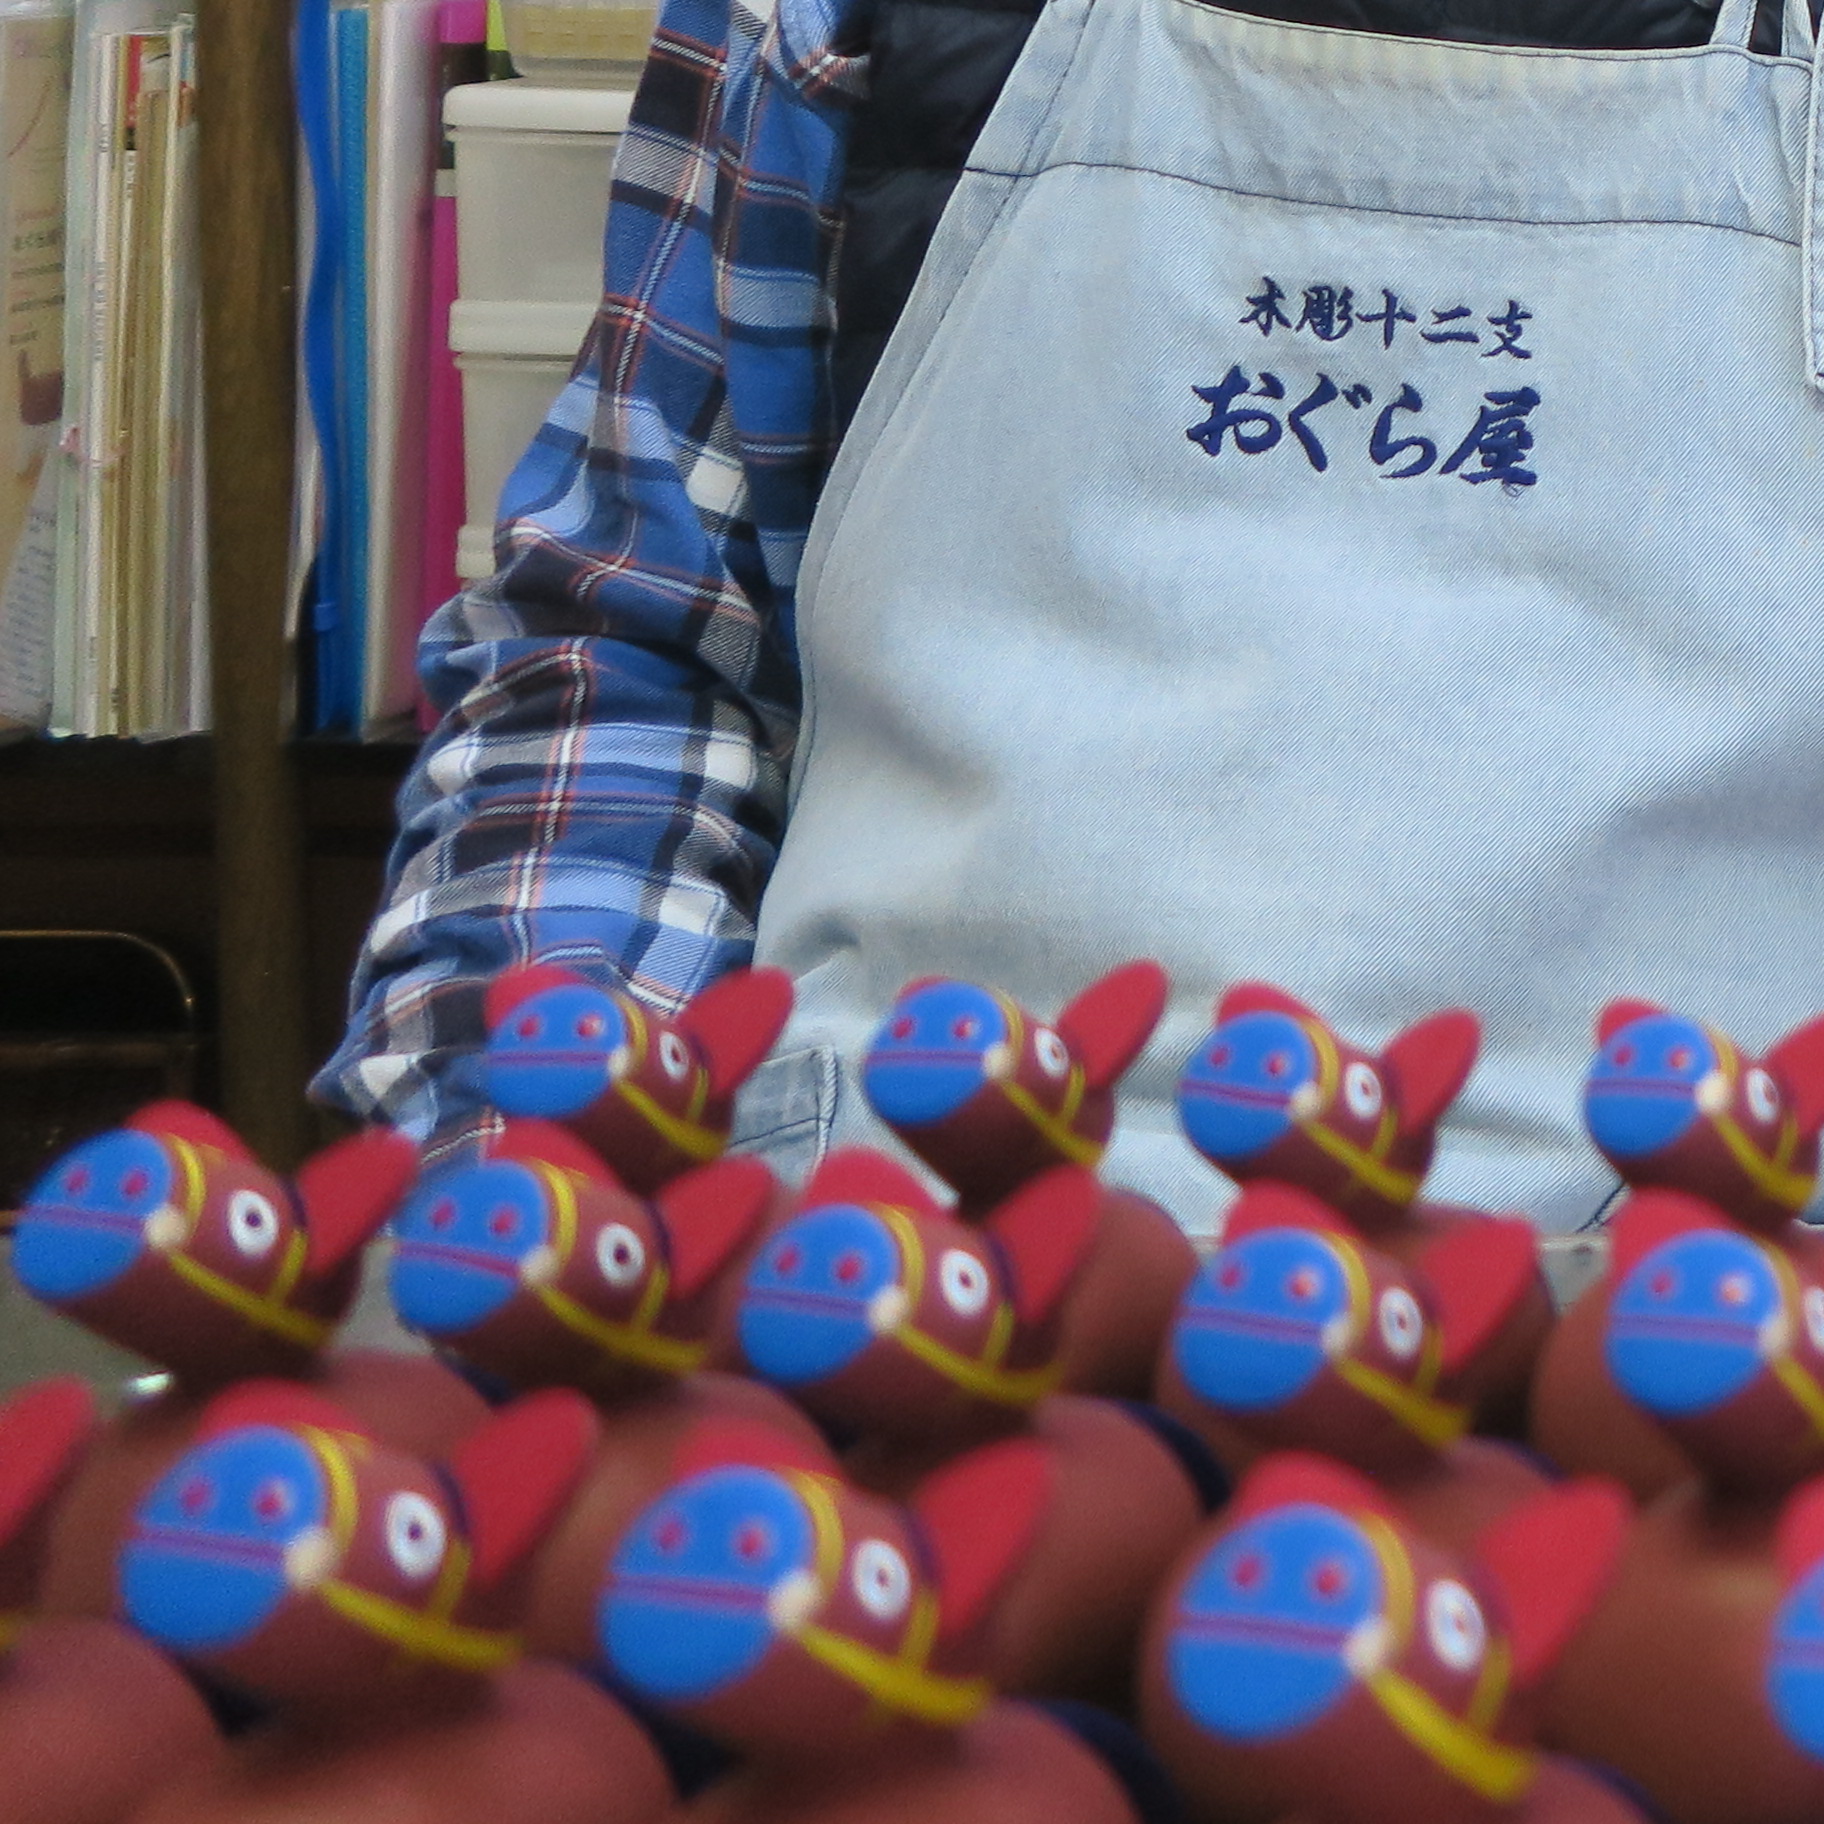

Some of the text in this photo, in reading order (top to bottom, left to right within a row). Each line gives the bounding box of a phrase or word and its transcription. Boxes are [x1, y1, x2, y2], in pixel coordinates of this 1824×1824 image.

[1239, 276, 1533, 360] 木彫十二支
[1187, 365, 1541, 487] おぐら屋
